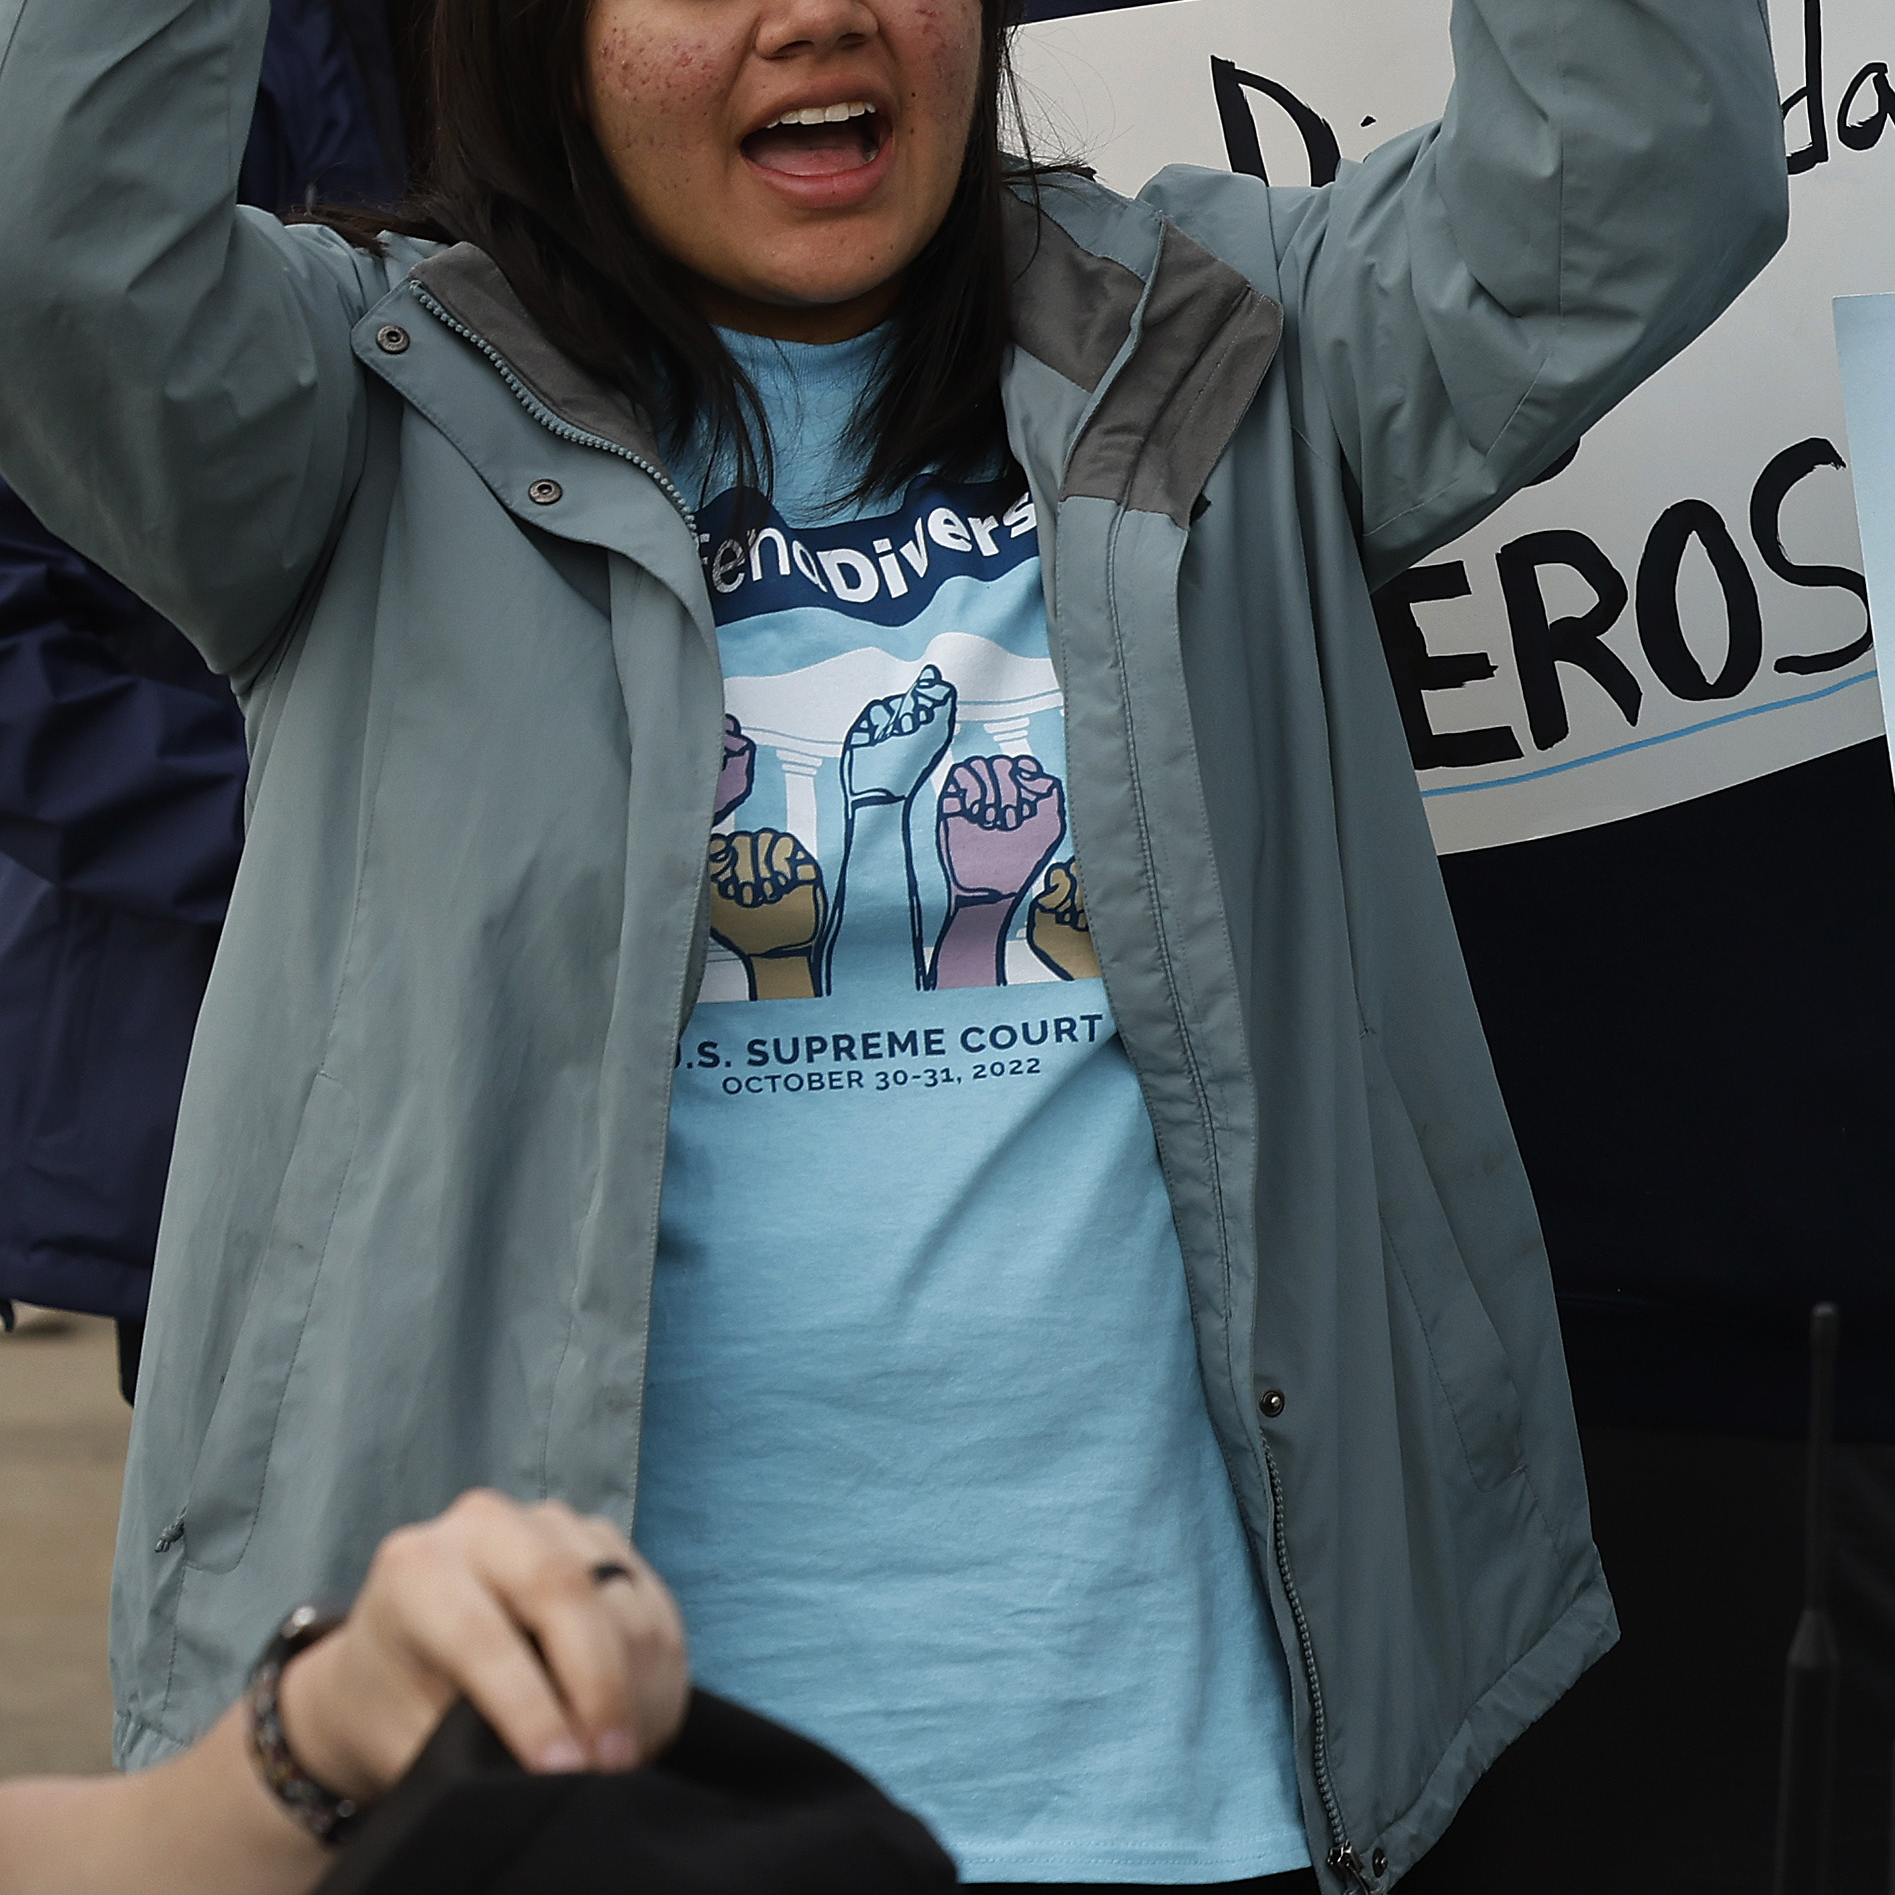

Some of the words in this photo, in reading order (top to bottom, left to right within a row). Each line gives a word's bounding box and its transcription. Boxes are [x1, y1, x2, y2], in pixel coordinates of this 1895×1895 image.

[746, 1028, 946, 1067] SUPREME
[959, 1013, 1104, 1053] COURT
[721, 1069, 865, 1096] OCTOBER
[875, 1066, 963, 1092] 30-31,
[972, 1056, 1042, 1081] 2022
